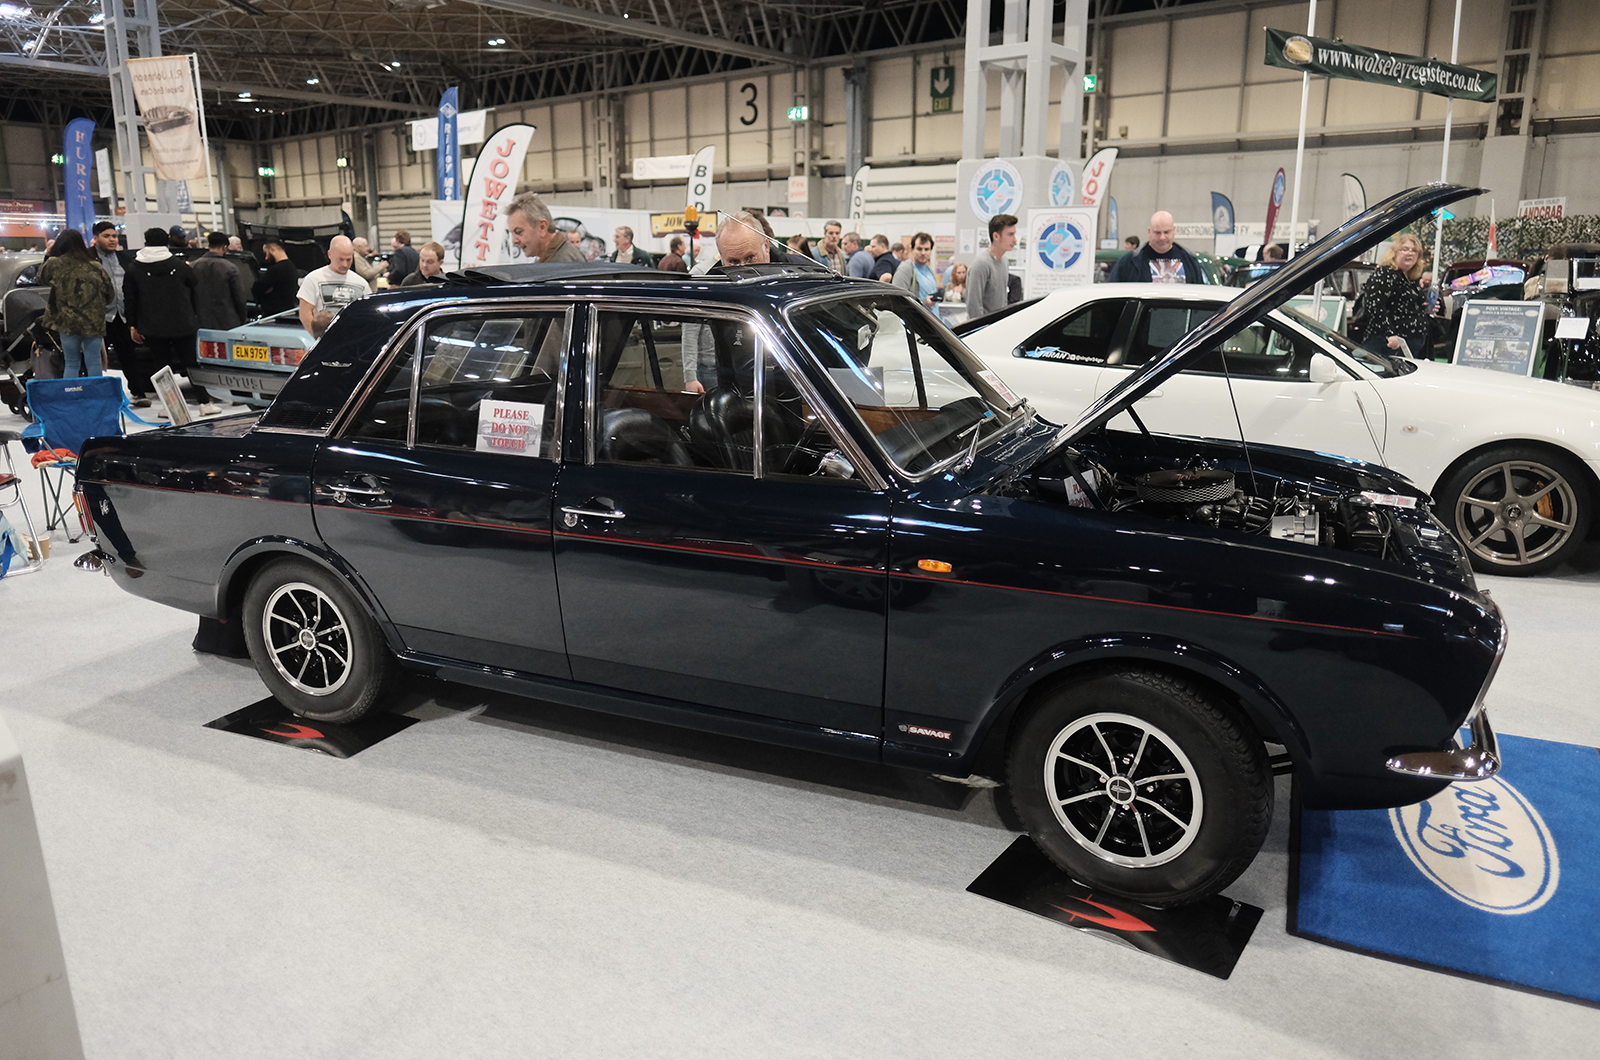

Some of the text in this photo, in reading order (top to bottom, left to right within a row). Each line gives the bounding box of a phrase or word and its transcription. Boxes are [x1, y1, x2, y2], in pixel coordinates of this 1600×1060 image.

[1317, 48, 1484, 92] www.wolseleyregister.co.uk
[740, 82, 758, 126] 3
[75, 130, 87, 207] HURST
[475, 138, 516, 262] JOWETT
[1519, 205, 1563, 219] LANDCRAB
[236, 346, 268, 359] ELN 975Y
[218, 374, 258, 390] LOTUS
[493, 408, 530, 420] PLEASE
[491, 422, 528, 435] DO NOT
[492, 437, 526, 449] TOUCH
[909, 727, 951, 739] SAVAGE
[1417, 785, 1525, 878] Ford
